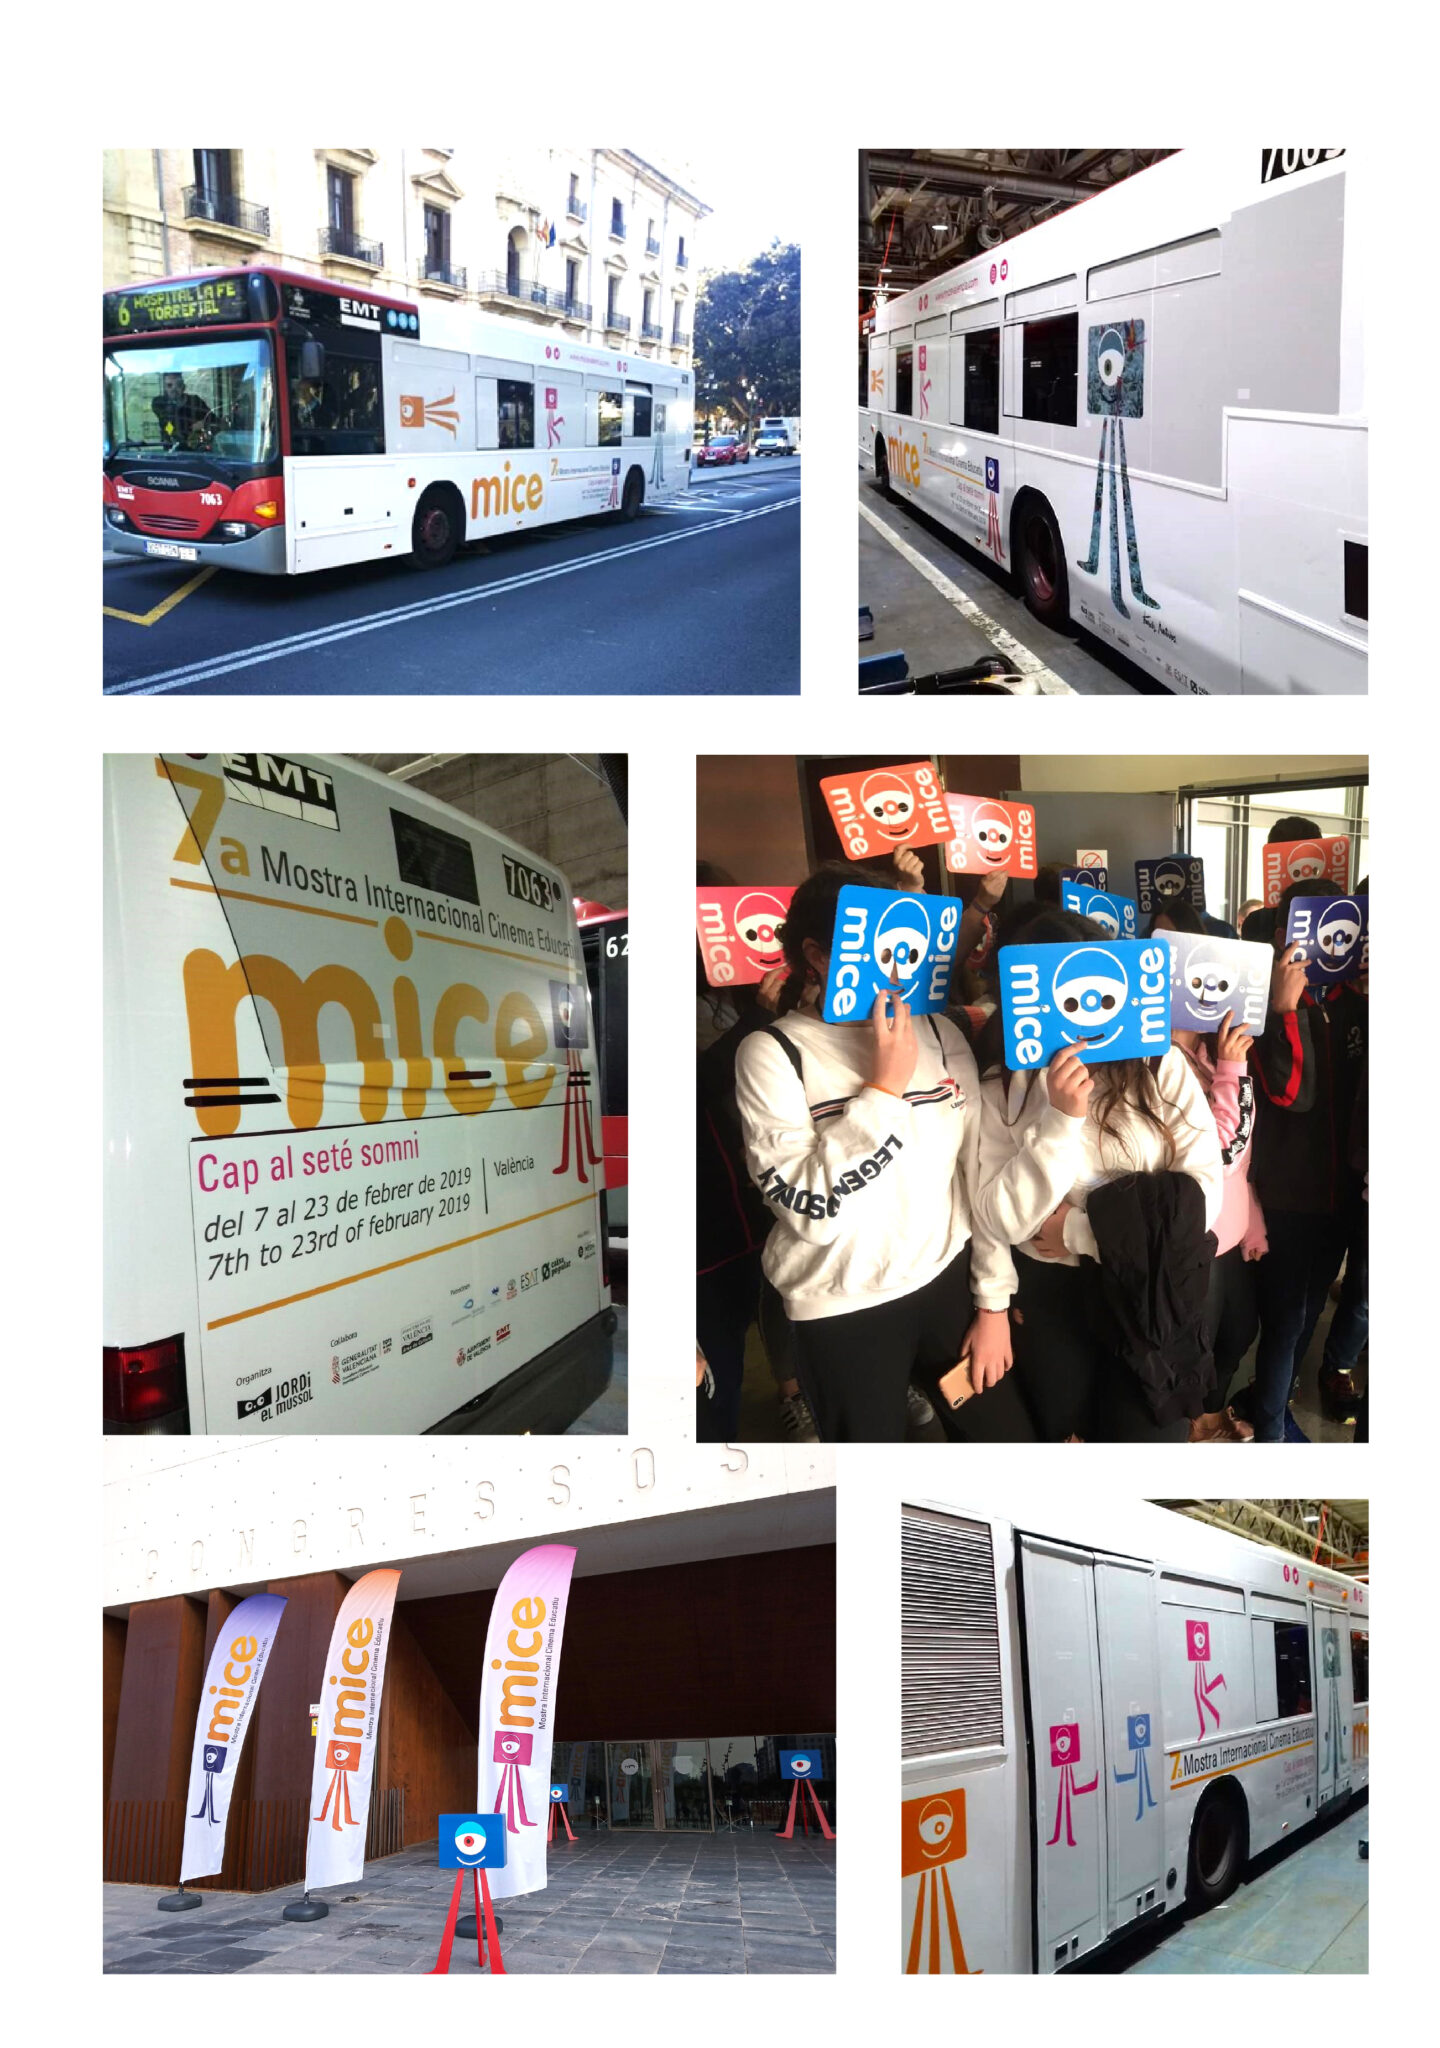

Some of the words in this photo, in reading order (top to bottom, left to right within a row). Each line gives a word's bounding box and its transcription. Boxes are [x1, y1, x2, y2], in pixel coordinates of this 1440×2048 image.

[119, 297, 130, 326] 6
[134, 289, 194, 308] HOSPITAL
[196, 284, 213, 300] LA
[217, 281, 236, 298] FE
[148, 300, 219, 320] TORREFIEL
[340, 298, 380, 319] EMT
[147, 476, 180, 487] SCANIA
[888, 425, 920, 488] mice
[200, 493, 223, 506] 7063
[471, 460, 543, 519] mice
[219, 753, 333, 801] EMT
[914, 767, 951, 835] mice
[829, 786, 870, 857] mice
[949, 804, 972, 870] mice
[1015, 808, 1035, 870] mice
[154, 757, 251, 878] 7a
[260, 845, 358, 903] Mostra
[365, 874, 485, 935] Internacional
[488, 912, 534, 949] Cinema
[1267, 853, 1286, 905] mice
[503, 857, 554, 913] 7063
[1138, 868, 1154, 912] mice
[699, 902, 735, 985] mice
[1121, 904, 1136, 939] ice
[1290, 910, 1315, 963] mic
[832, 906, 871, 1017] mice
[928, 904, 958, 1001] mice
[1010, 963, 1052, 1066] mice
[1131, 945, 1167, 1044] mice
[1239, 969, 1265, 1025] mic
[182, 916, 557, 1137] mice
[198, 1153, 259, 1194] Cap
[270, 1145, 293, 1181] al
[302, 1138, 352, 1176] seté
[360, 1131, 419, 1167] somni
[494, 1156, 535, 1177] València
[204, 1210, 244, 1243] del
[254, 1206, 268, 1232] 7
[276, 1200, 296, 1227] al
[304, 1195, 329, 1221] 23
[336, 1190, 358, 1213] de
[365, 1181, 413, 1207] febrer
[418, 1175, 435, 1195] de
[440, 1167, 471, 1190] 2019
[208, 1247, 249, 1281] 7th
[260, 1243, 282, 1267] to
[291, 1224, 339, 1259] 23rd
[345, 1218, 364, 1243] of
[368, 1205, 434, 1237] february
[438, 1193, 470, 1218] 2019
[236, 1367, 272, 1387] Organitza
[549, 1597, 560, 1627] Educatiu
[491, 1596, 546, 1728] mice
[545, 1628, 555, 1654] Cinema
[207, 1635, 258, 1742] mice
[329, 1617, 373, 1738] mice
[541, 1655, 552, 1702] Internacional
[539, 1703, 548, 1730] Mostra
[1183, 1753, 1217, 1776] Mostra
[1219, 1737, 1268, 1766] Internacional
[1268, 1732, 1291, 1749] Cinema
